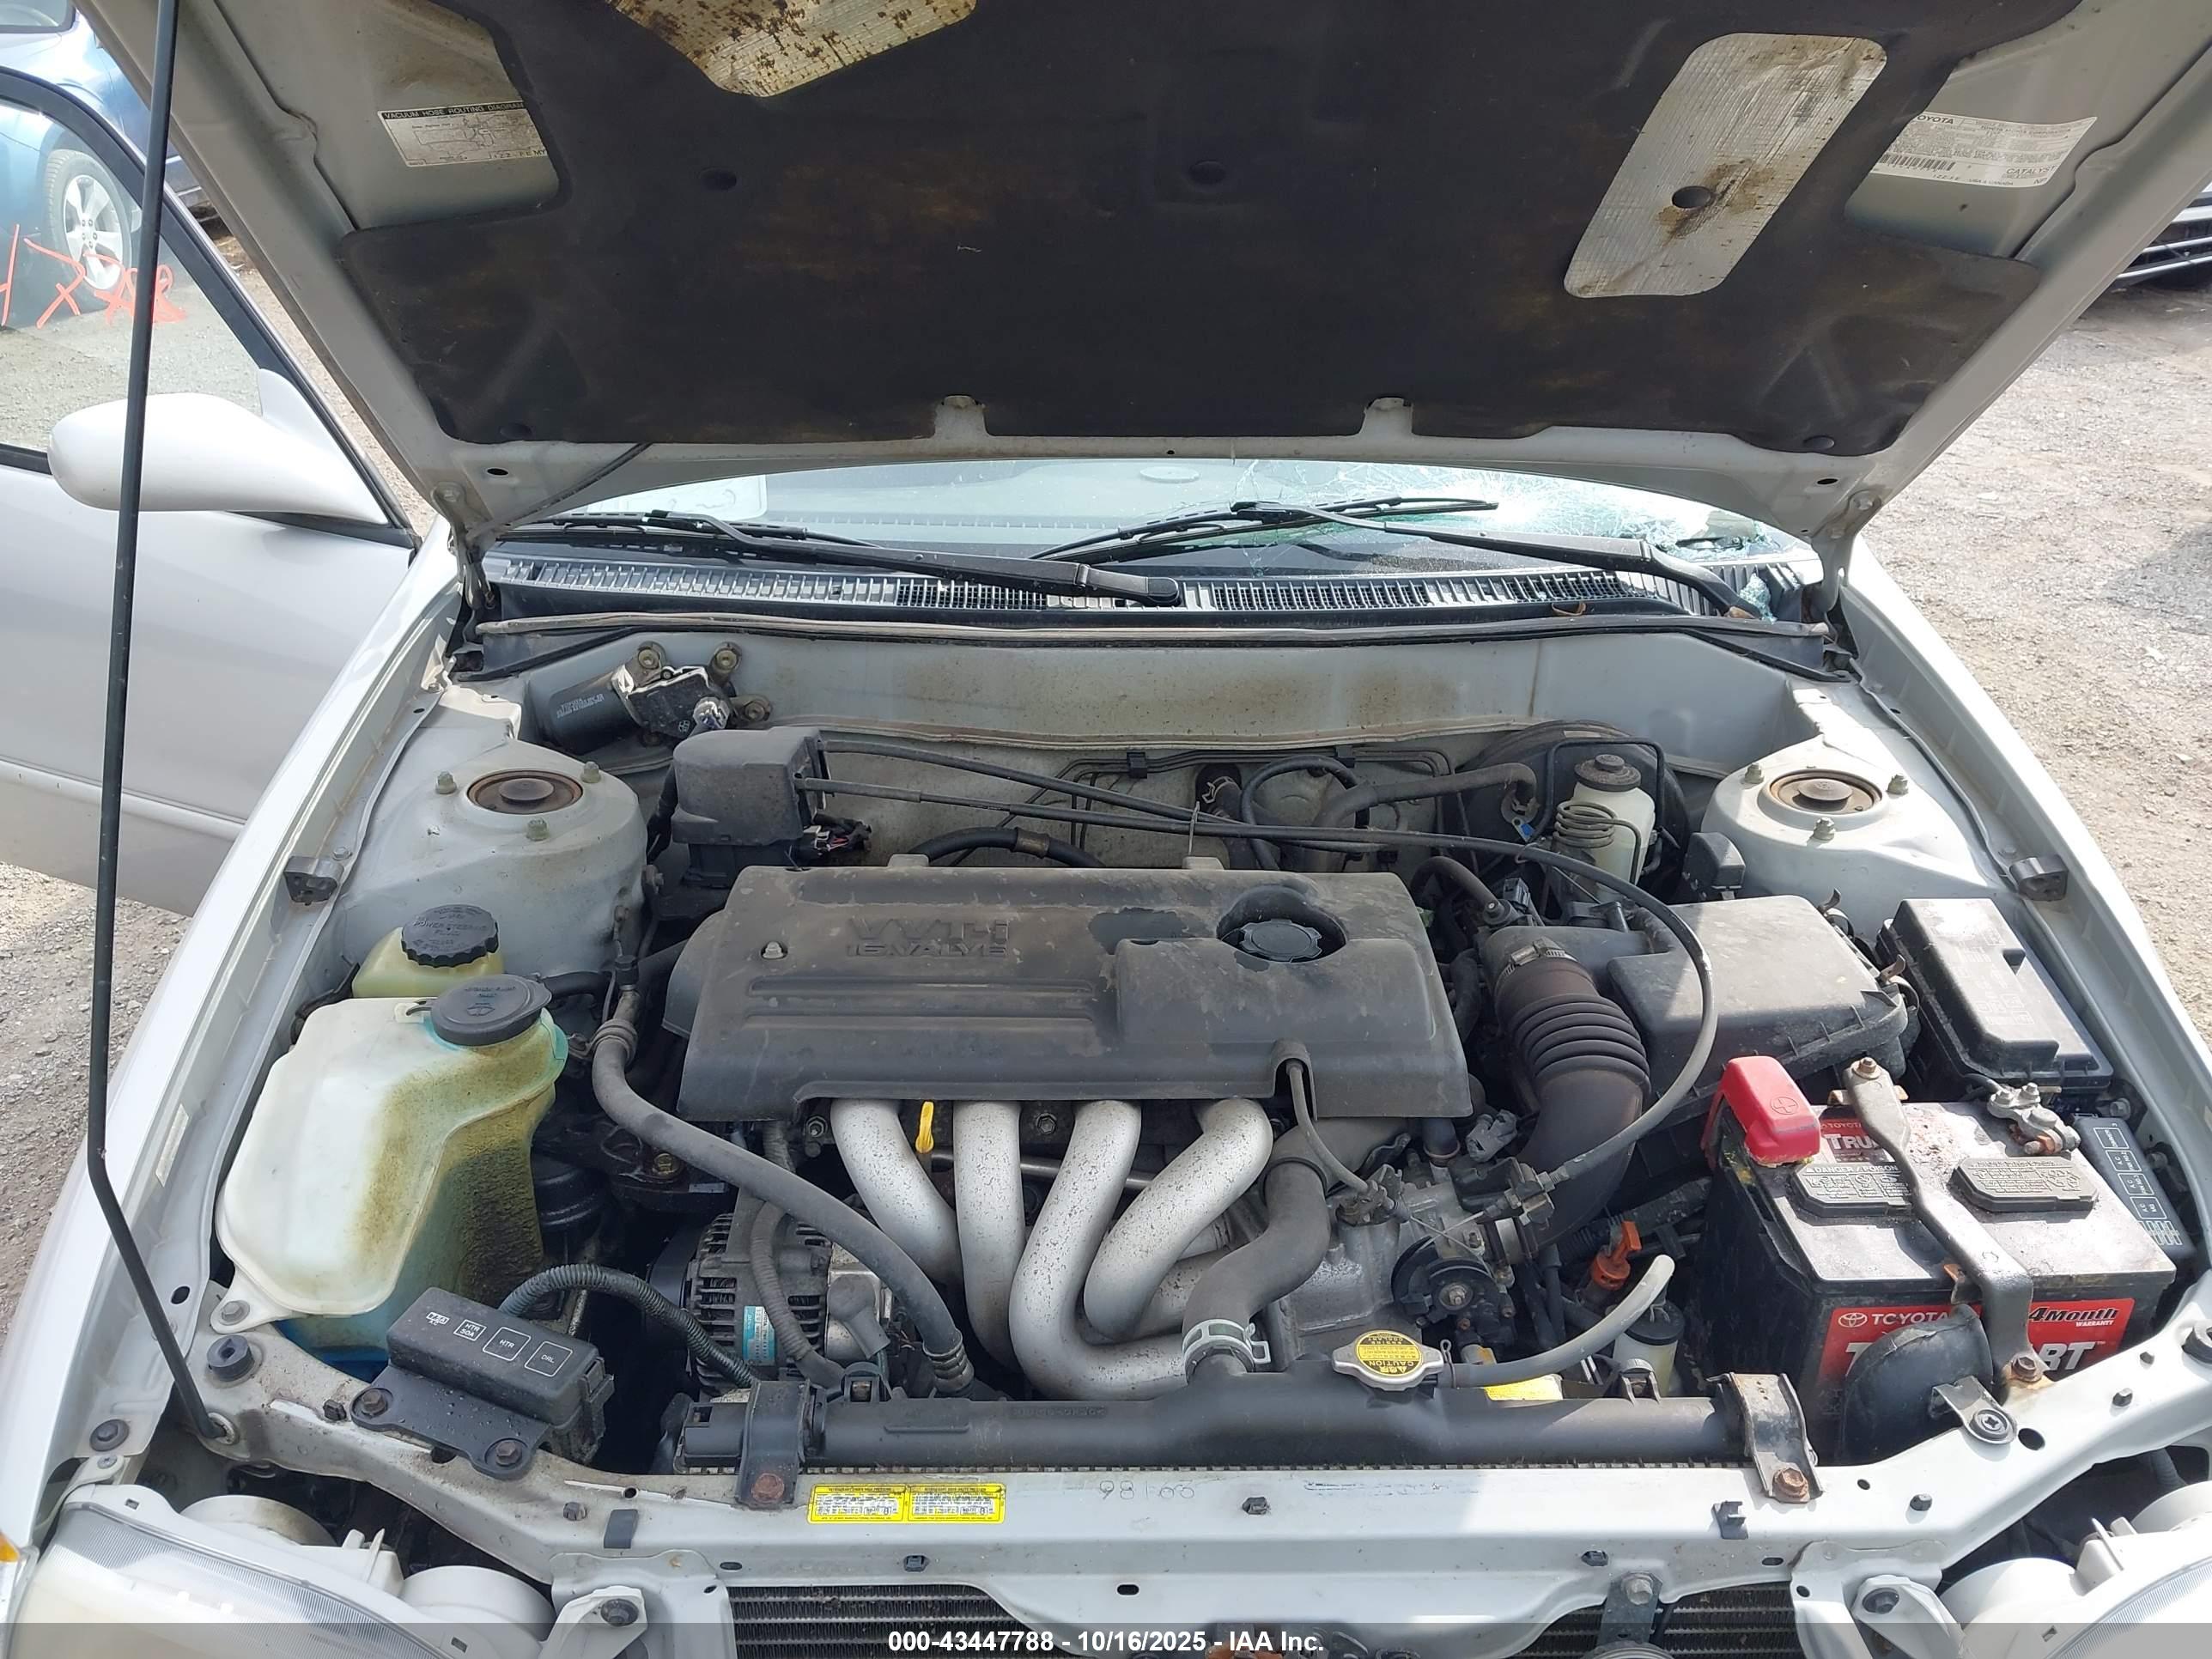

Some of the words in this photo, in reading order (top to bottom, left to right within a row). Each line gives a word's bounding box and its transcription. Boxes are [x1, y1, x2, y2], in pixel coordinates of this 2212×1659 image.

[448, 106, 483, 114] ROUTING
[487, 102, 524, 111] DIAGRAM
[1917, 114, 1954, 125] OYOTA
[1823, 1133, 1880, 1150] TRU
[1872, 1311, 1949, 1325] TOYOTA
[2027, 1306, 2119, 1322] 4Month
[465, 1323, 481, 1332] HTR
[499, 1339, 515, 1349] HTR
[540, 1354, 556, 1364] DRL
